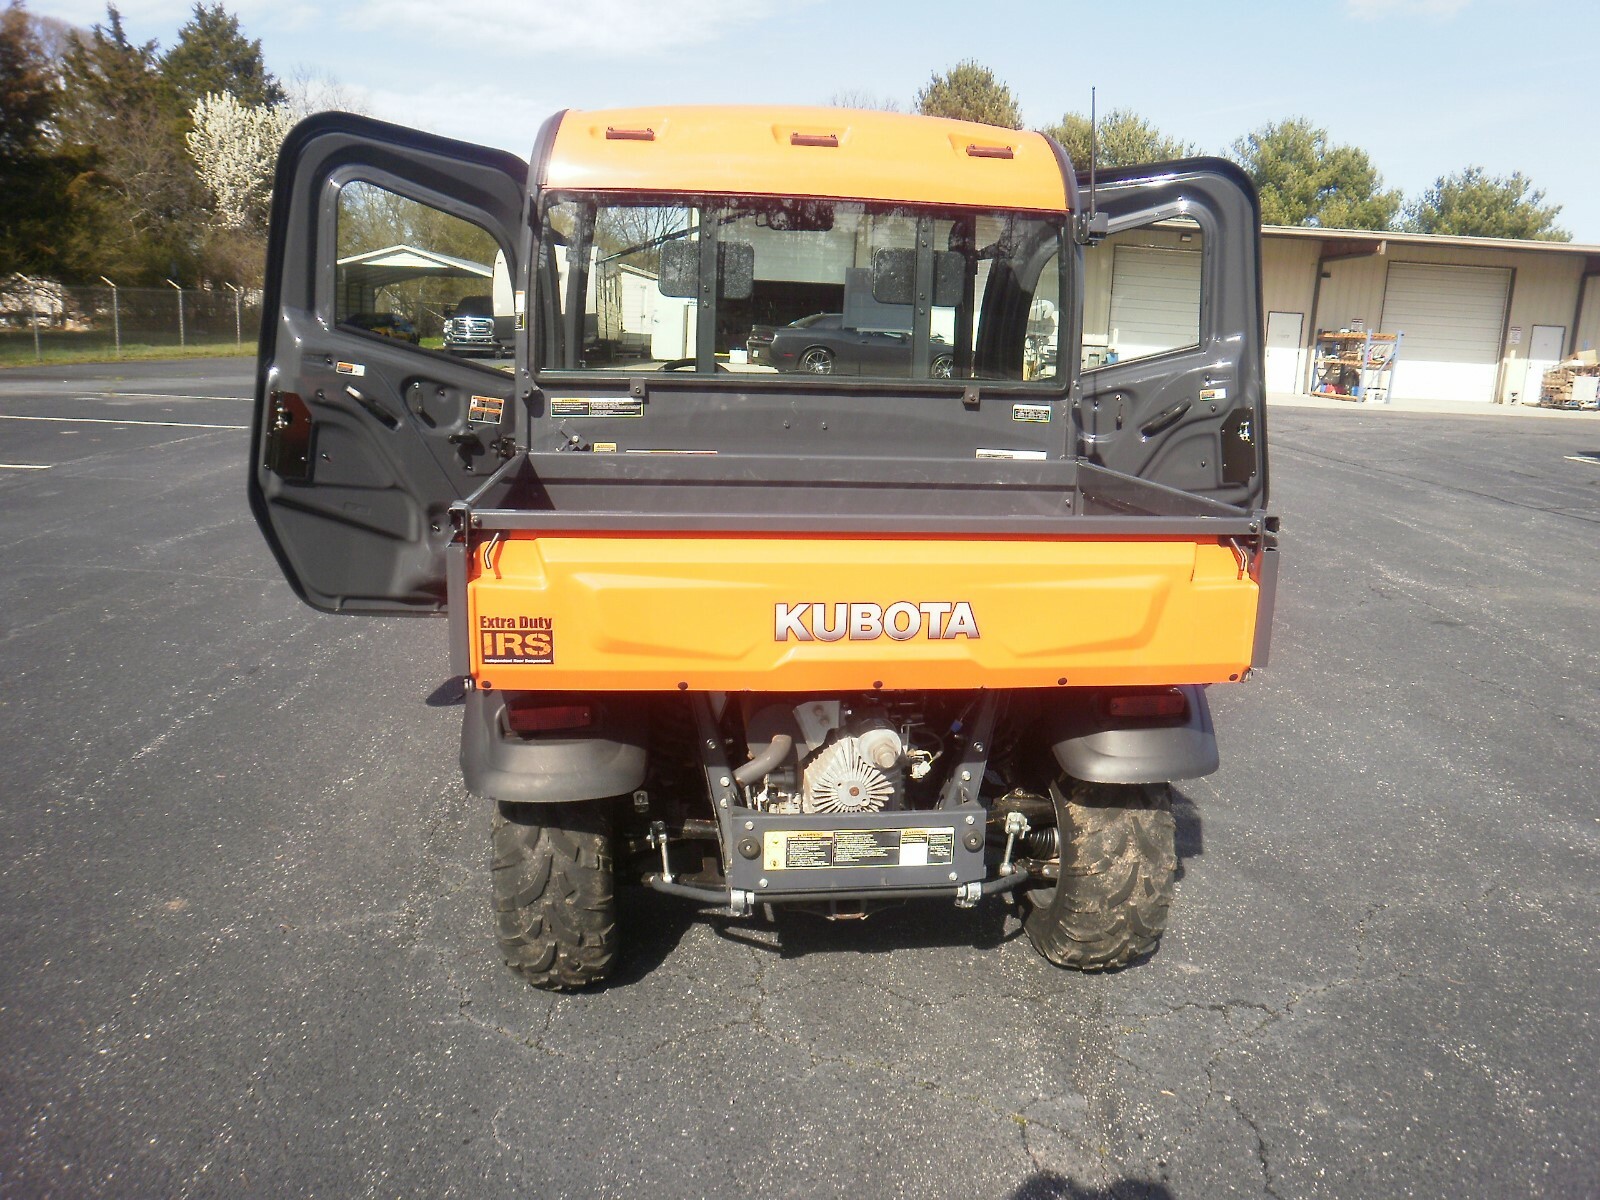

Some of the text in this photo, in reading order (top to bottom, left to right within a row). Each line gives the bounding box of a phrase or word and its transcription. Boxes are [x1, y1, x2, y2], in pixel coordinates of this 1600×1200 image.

[480, 616, 552, 629] Extra Duty
[774, 601, 980, 641] KUBOTA
[483, 632, 552, 656] IRS
